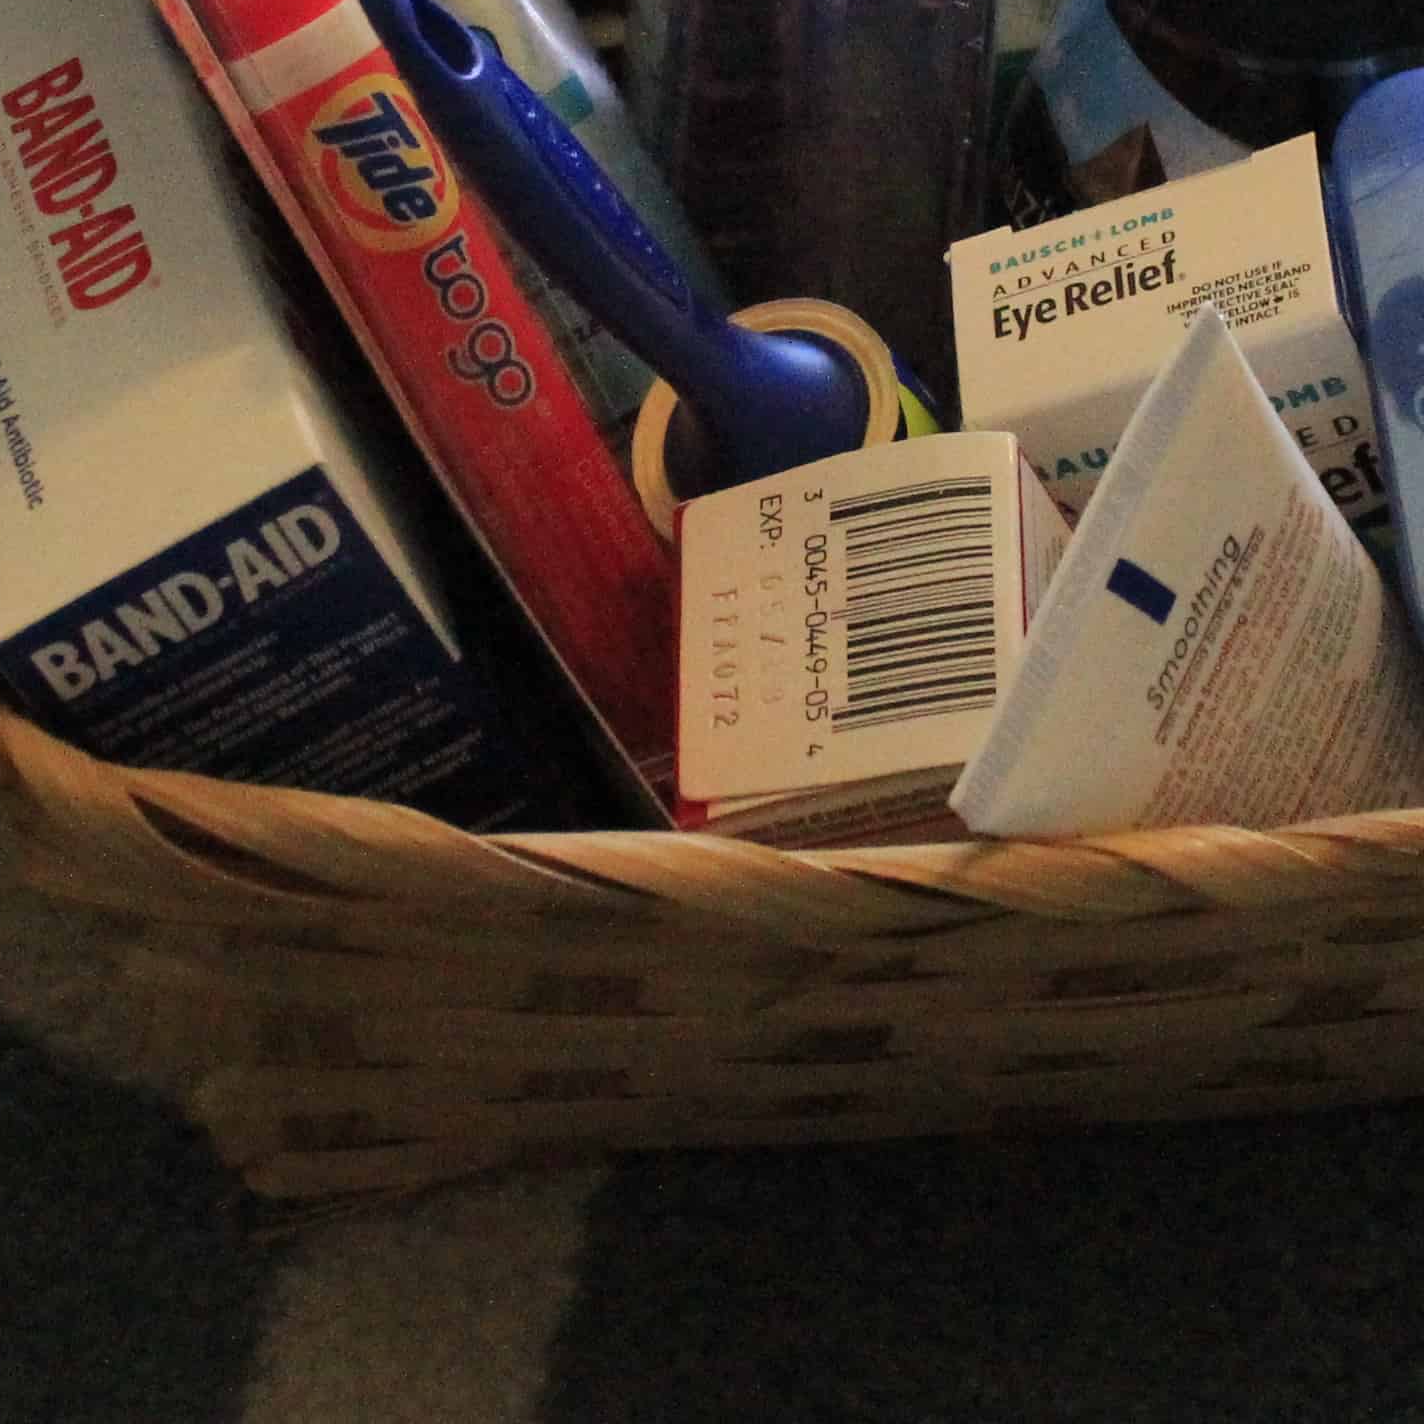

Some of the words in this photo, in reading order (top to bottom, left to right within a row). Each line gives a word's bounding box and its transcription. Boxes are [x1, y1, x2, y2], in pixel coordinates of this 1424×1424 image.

[1, 56, 153, 312] BAND-AID
[313, 91, 439, 225] Tide
[989, 233, 1085, 274] BAUSCH
[1110, 207, 1176, 237] LOMB
[992, 231, 1176, 299] ADVANCED
[1191, 282, 1212, 295] DO
[1215, 273, 1241, 287] NOT
[1244, 266, 1269, 279] USE
[1238, 263, 1312, 292] NECKBAND
[993, 295, 1057, 341] Eye
[1064, 248, 1178, 316] Relief
[1272, 375, 1349, 414] OMB
[1, 413, 45, 511] Antibiotic
[759, 493, 785, 551] EXP:
[30, 503, 344, 704] BAND-AID
[803, 532, 830, 723] 0045-0449-05
[1146, 534, 1241, 712] Smoothing
